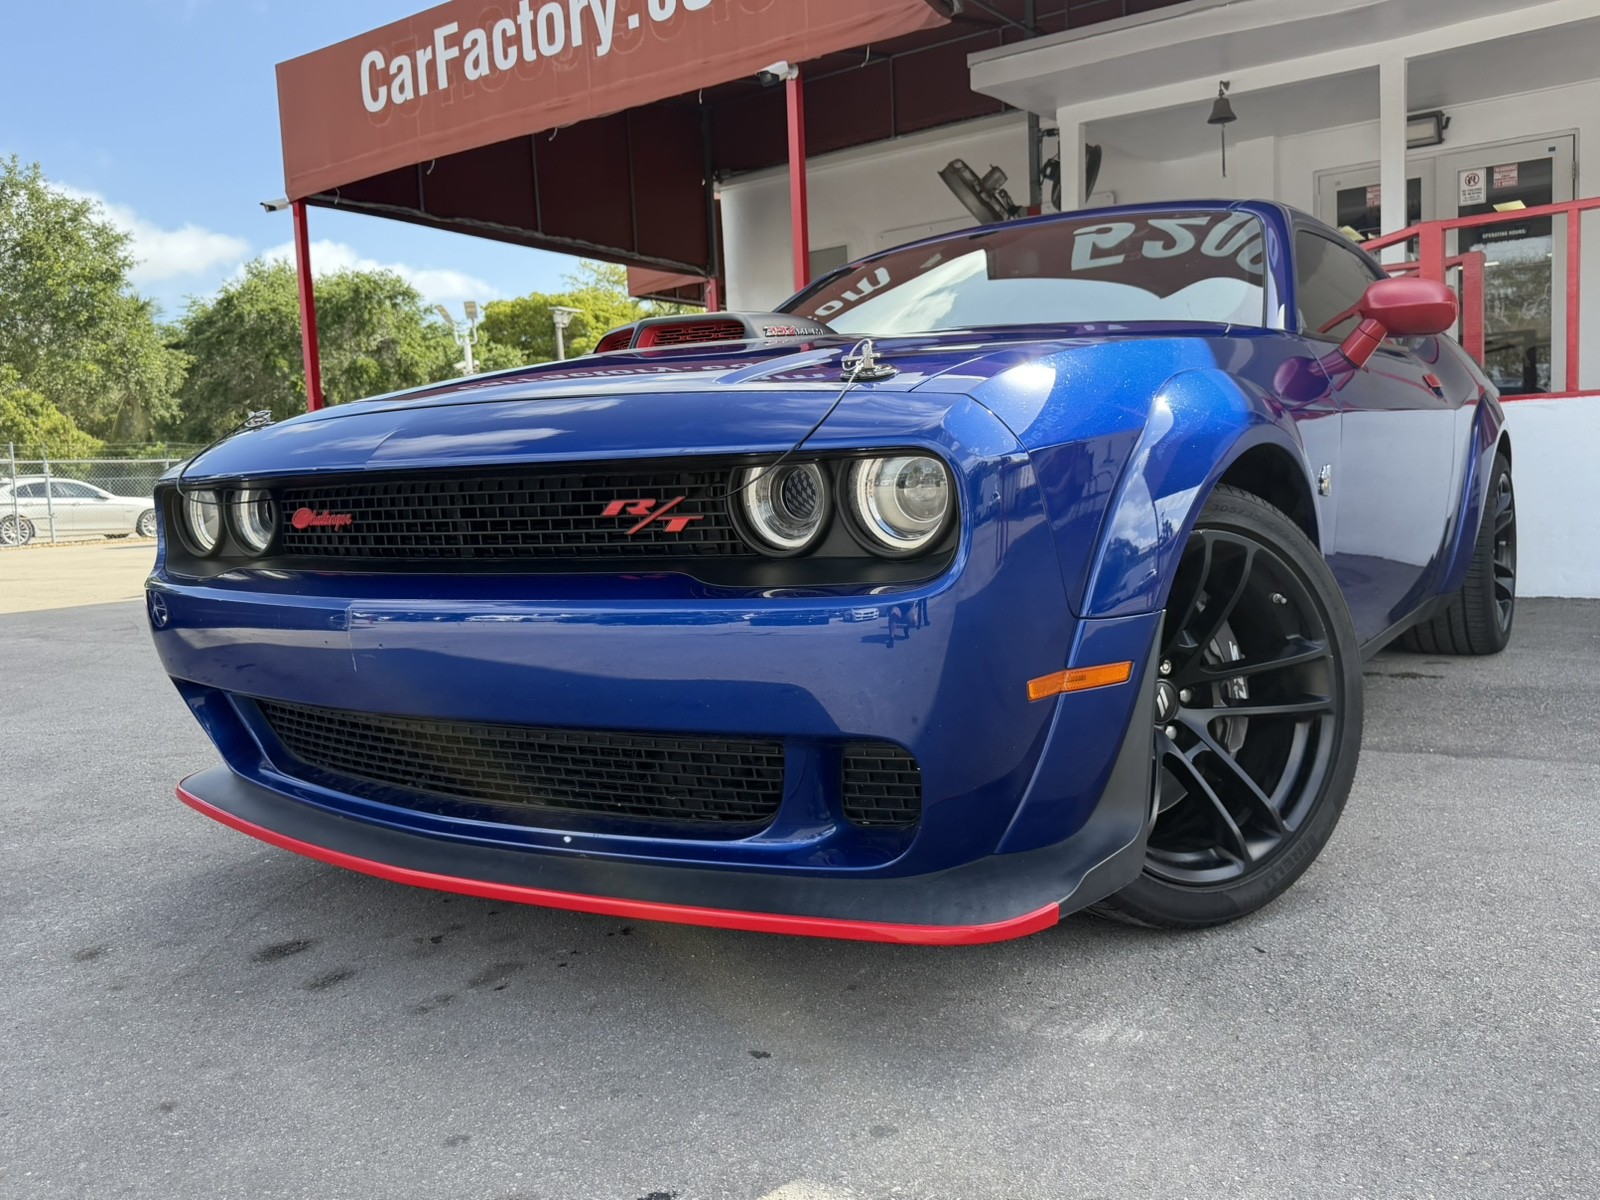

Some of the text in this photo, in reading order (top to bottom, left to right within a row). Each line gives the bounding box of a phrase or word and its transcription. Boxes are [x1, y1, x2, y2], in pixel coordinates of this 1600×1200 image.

[360, 0, 711, 113] CarFactory.
[291, 507, 353, 532] Challenger
[601, 496, 704, 534] R/T
